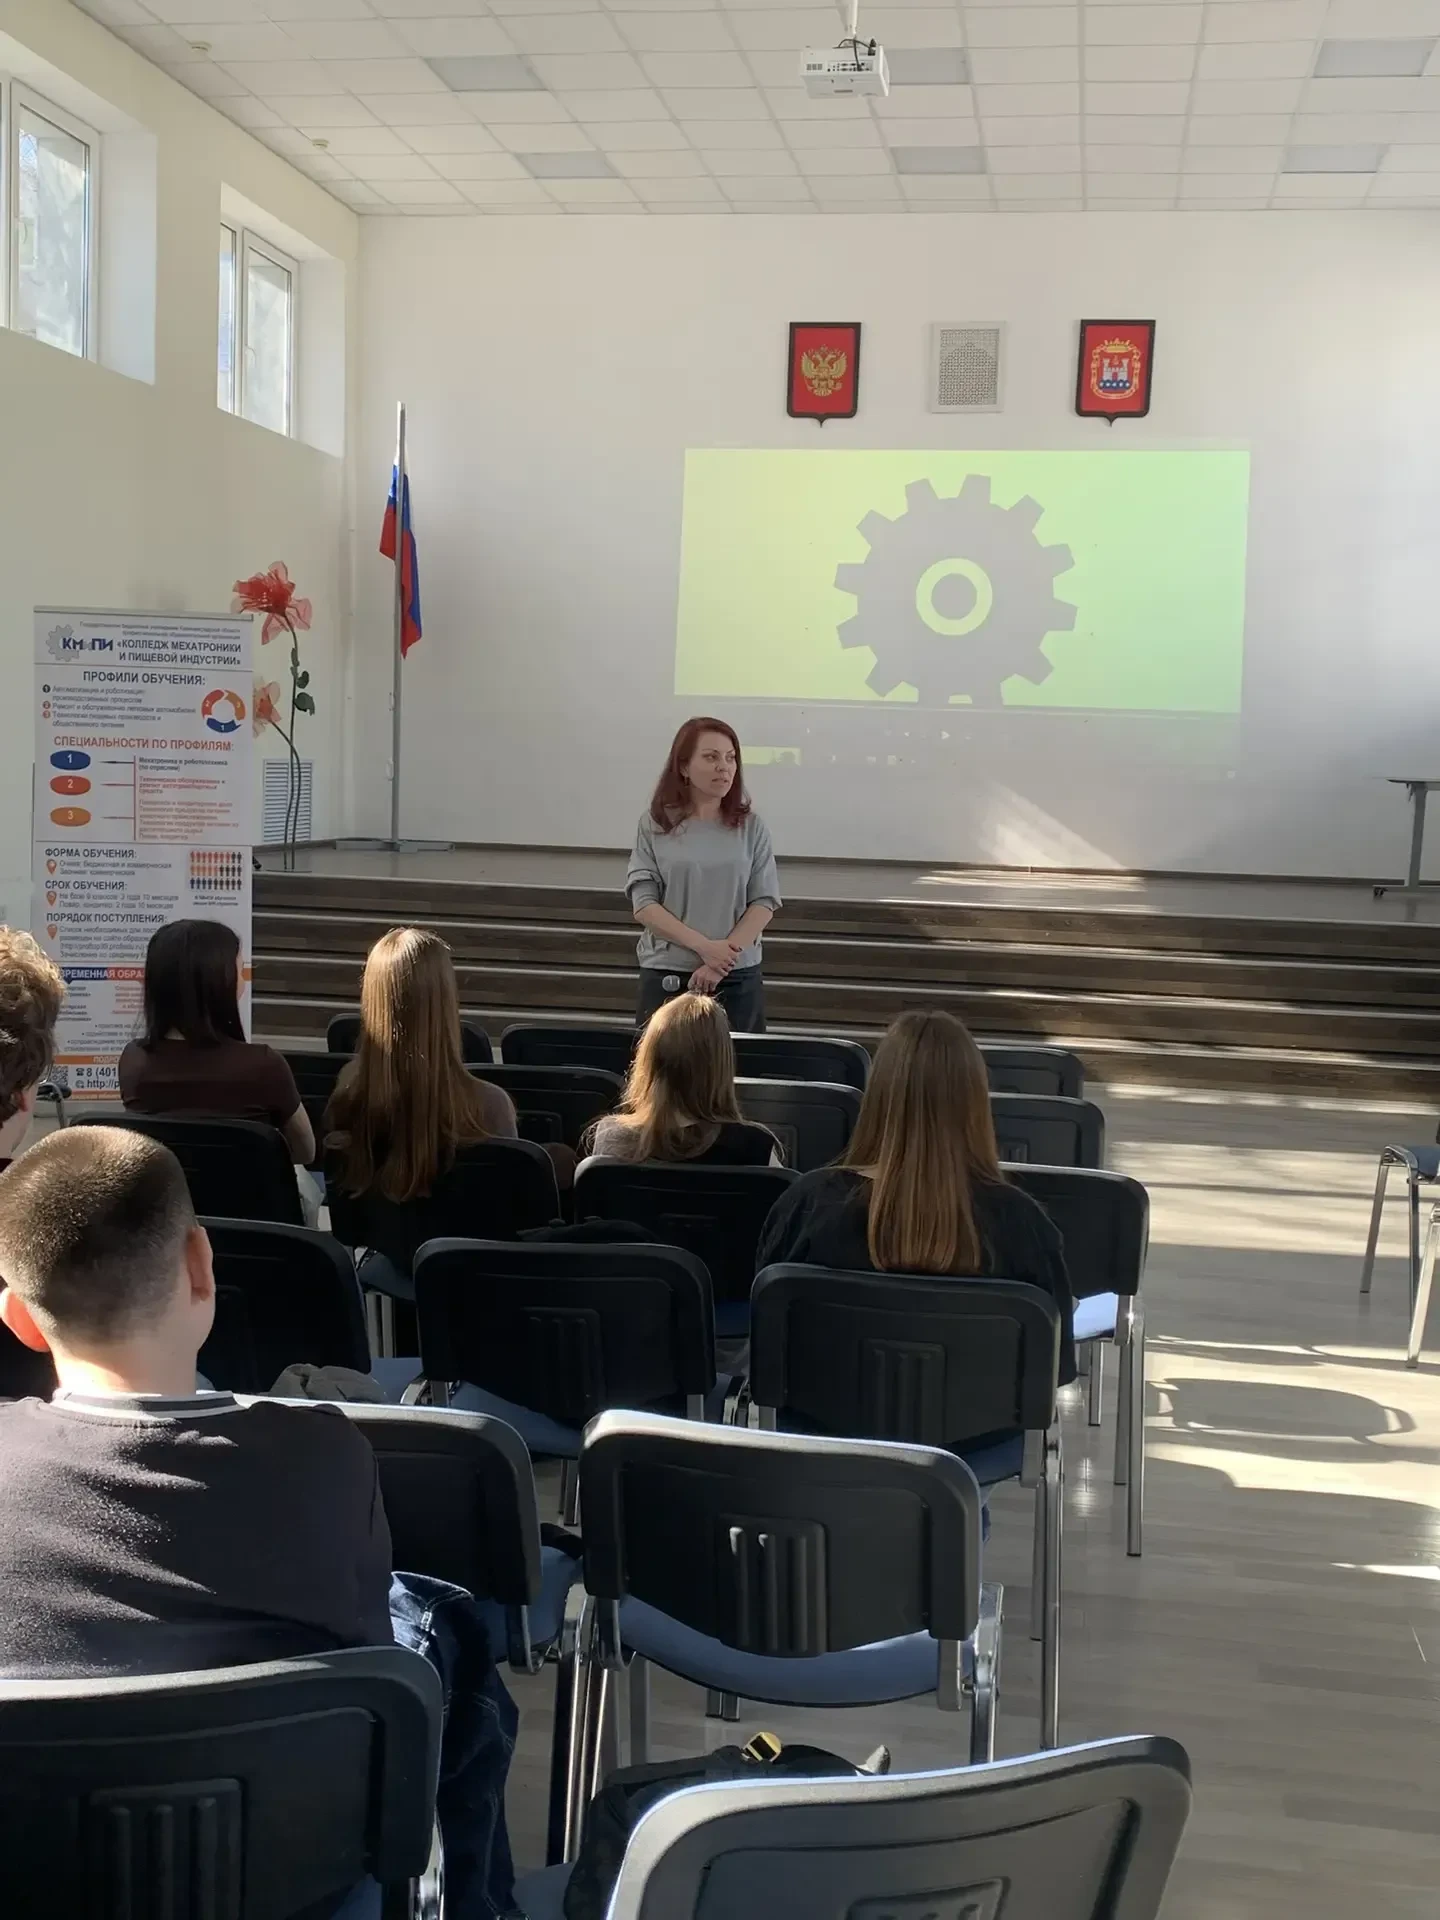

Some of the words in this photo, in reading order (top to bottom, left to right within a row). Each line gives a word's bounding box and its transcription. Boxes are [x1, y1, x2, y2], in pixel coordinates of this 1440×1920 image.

[117, 639, 169, 650] «КОЛЛЕДЖ
[171, 641, 242, 653] МЕХАТРОНИКИ
[119, 652, 126, 661] И
[128, 652, 178, 663] ПИЩЕВОЙ
[180, 654, 241, 665] ИНДУСТРИИ»
[83, 671, 139, 683] ПРОФИЛИ
[141, 673, 206, 686] ОБУЧЕНИЯ:
[53, 736, 149, 749] СПЕЦИАЛЬНОСТИ
[152, 739, 168, 749] ПО
[170, 739, 235, 752] ПРОФИЛЯМ:
[67, 753, 73, 764] 1
[67, 779, 74, 789] 2
[67, 810, 74, 820] 3
[45, 848, 80, 857] ФОРМА
[82, 849, 137, 859] ОБУЧЕНИЯ:
[72, 881, 128, 890] ОБУЧЕНИЯ:
[46, 913, 92, 923] ПОРЯДОК
[94, 914, 168, 924] ПОСТУПЛЕНИЯ:
[61, 969, 115, 978] ВРЕМЕННАЯ
[117, 970, 145, 979] ОБРА
[86, 1067, 93, 1077] 8
[95, 1067, 117, 1080] (401
[87, 1079, 120, 1090] http://p
